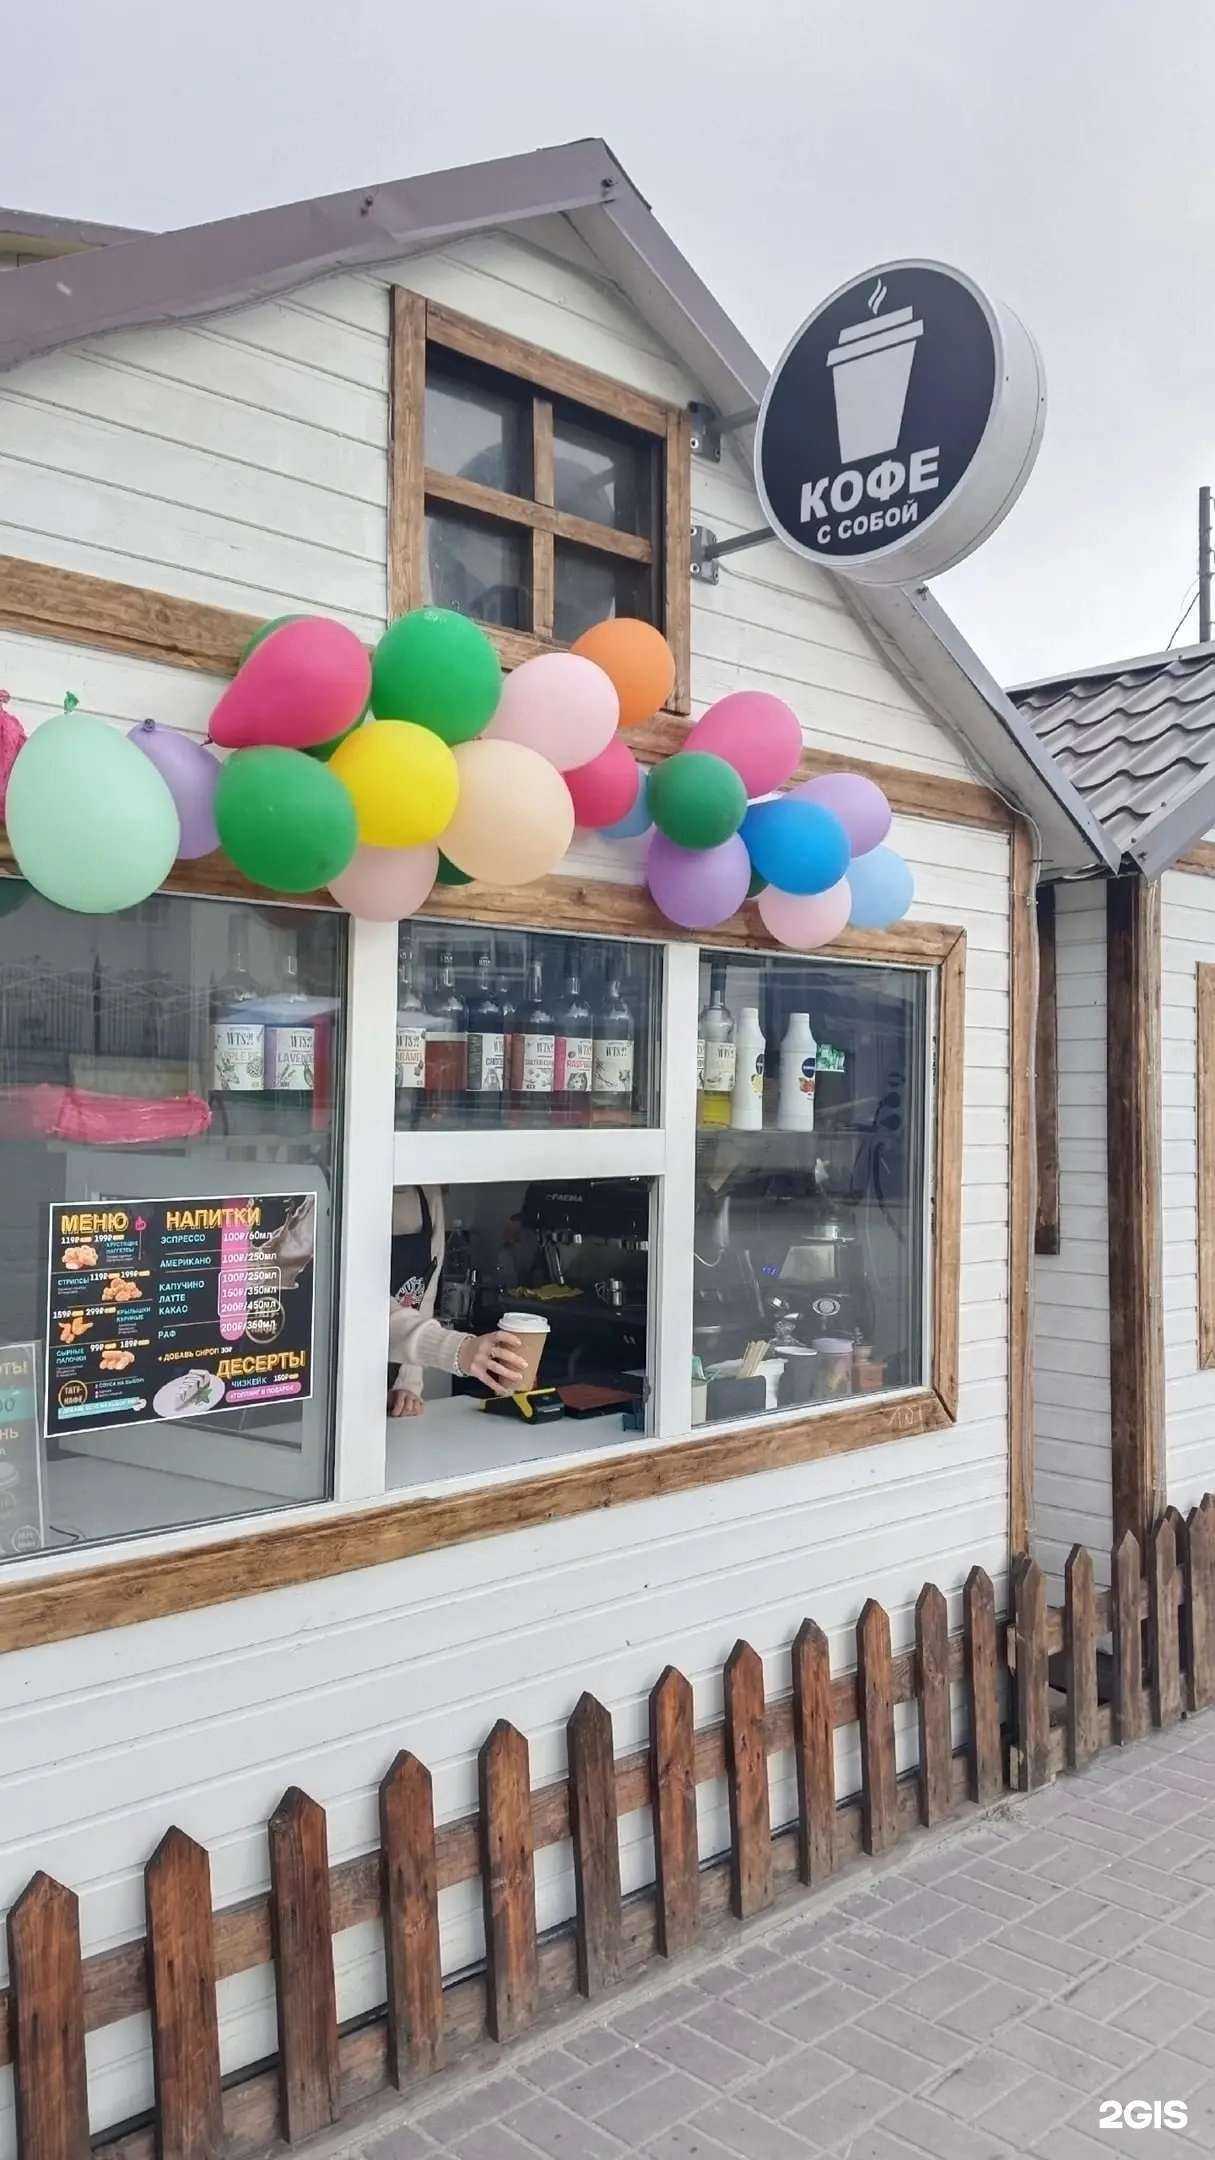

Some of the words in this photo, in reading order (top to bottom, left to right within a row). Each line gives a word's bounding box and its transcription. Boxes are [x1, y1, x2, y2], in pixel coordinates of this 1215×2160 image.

[800, 446, 940, 523] КОФЕ
[838, 499, 918, 539] СОБОЙ
[61, 1212, 129, 1234] МЕНЮ
[166, 1207, 262, 1231] НАПИТКИ
[160, 1233, 206, 1244] ЭСПРЕССО
[160, 1256, 212, 1268] АМЕРИКАНО
[159, 1280, 205, 1291] КАПУЧИНО
[159, 1293, 186, 1303] ЛАТТЕ
[159, 1305, 188, 1316] КАКАО
[158, 1330, 176, 1339] РАФ
[217, 1350, 306, 1379] ДЕСЕРТЫ
[231, 1376, 268, 1388] ЧИЗКЕЙК
